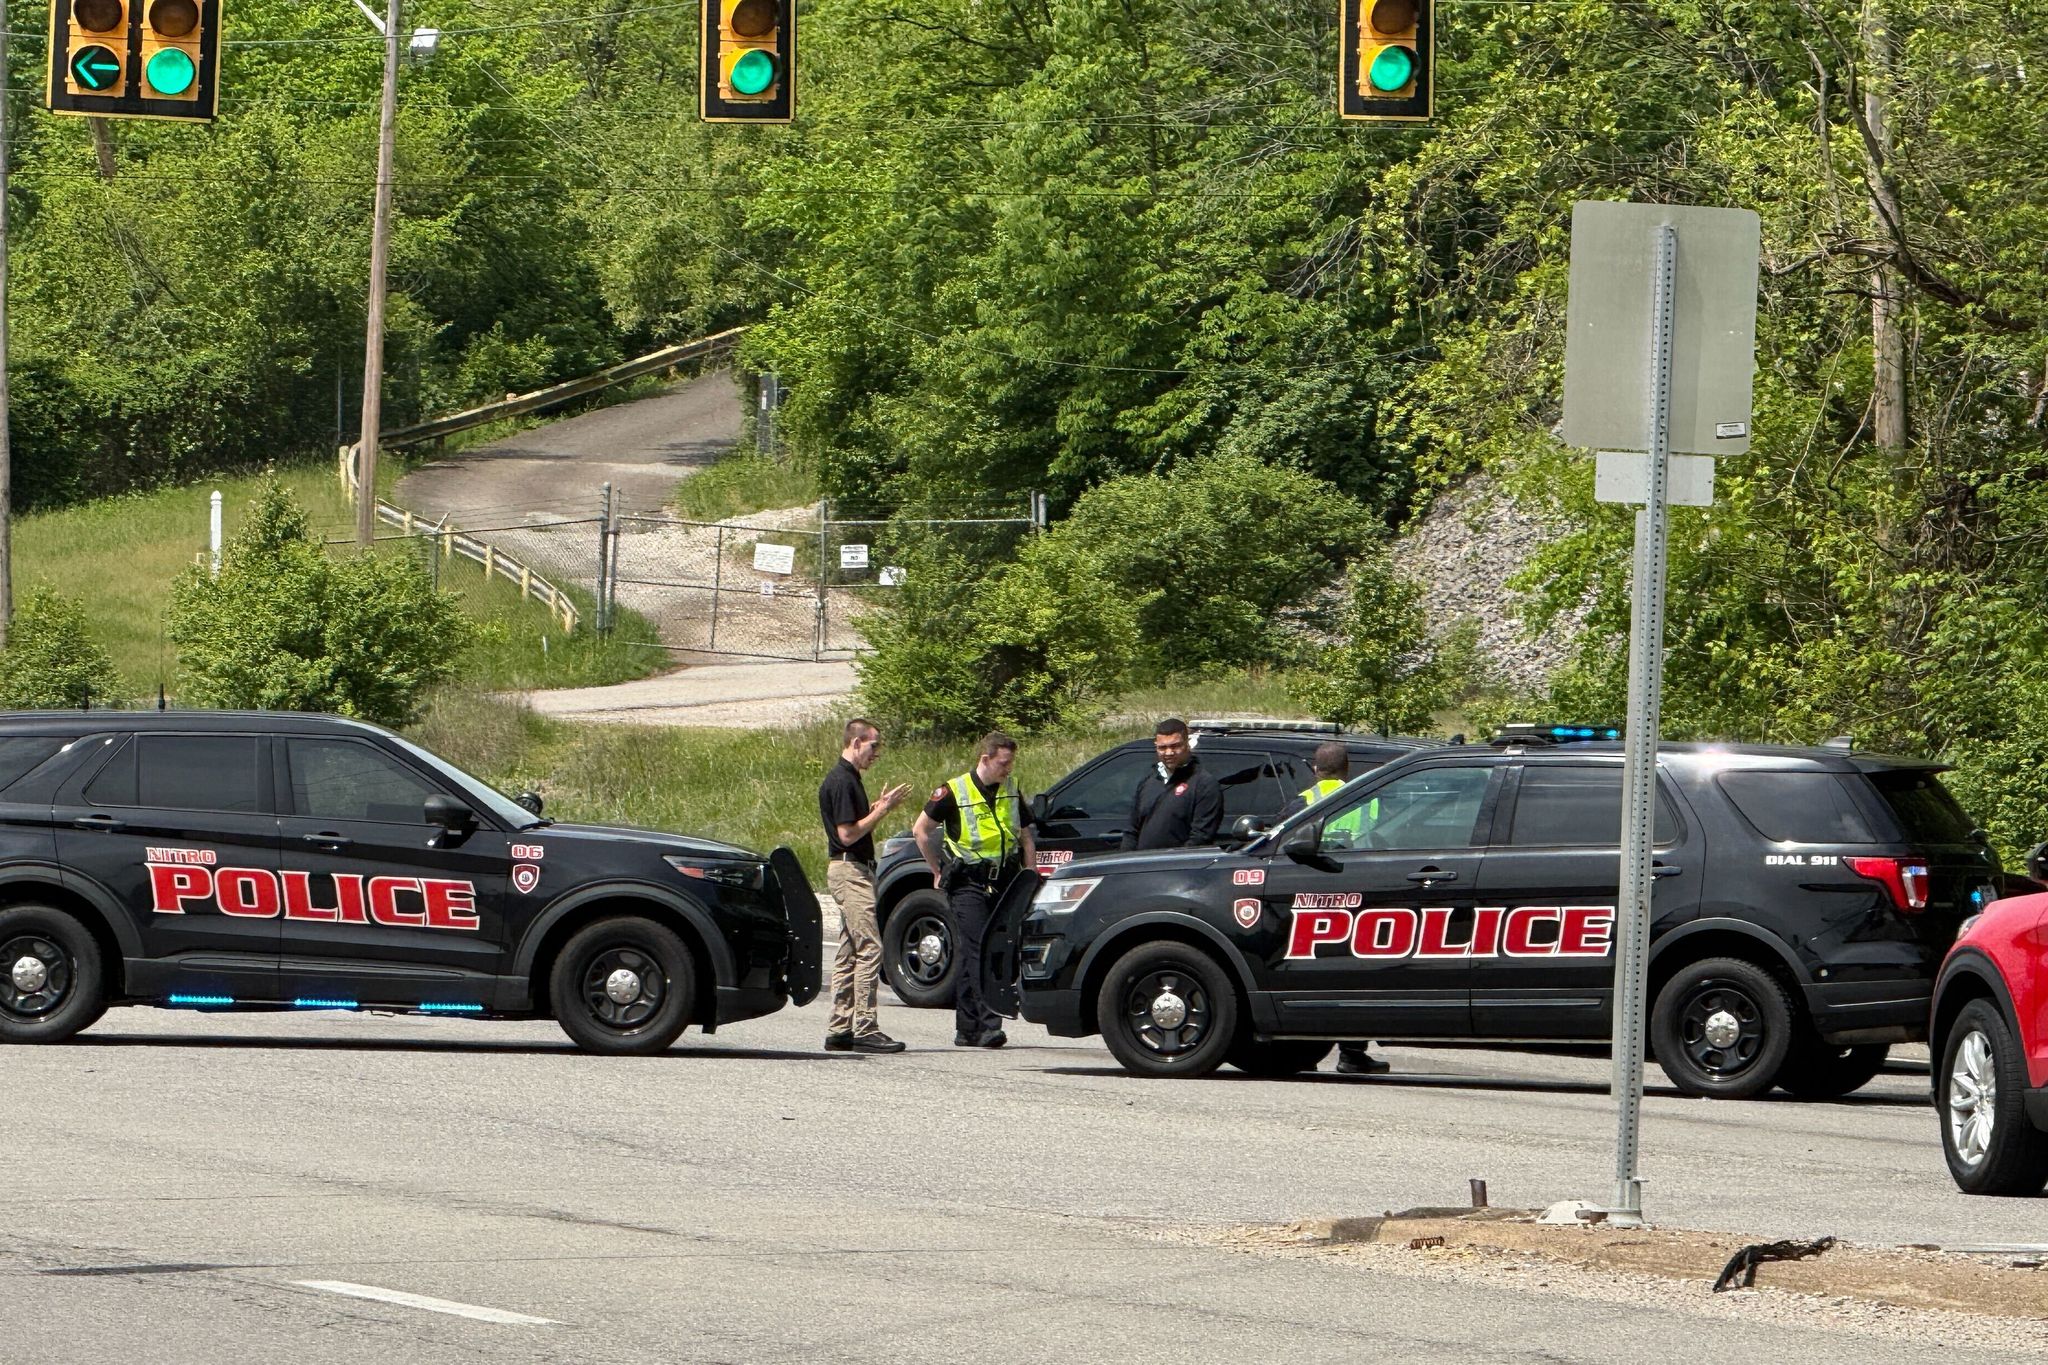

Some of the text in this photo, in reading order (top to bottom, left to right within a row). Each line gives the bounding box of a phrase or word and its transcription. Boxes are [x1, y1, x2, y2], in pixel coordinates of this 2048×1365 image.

[145, 847, 217, 865] NITRO
[511, 845, 544, 860] 06
[1035, 850, 1074, 864] ITRO
[1765, 855, 1838, 866] DIAL 911
[1233, 869, 1265, 885] 09
[143, 862, 480, 931] POLICE
[1291, 892, 1363, 909] NITRO
[1283, 906, 1616, 960] POLICE
